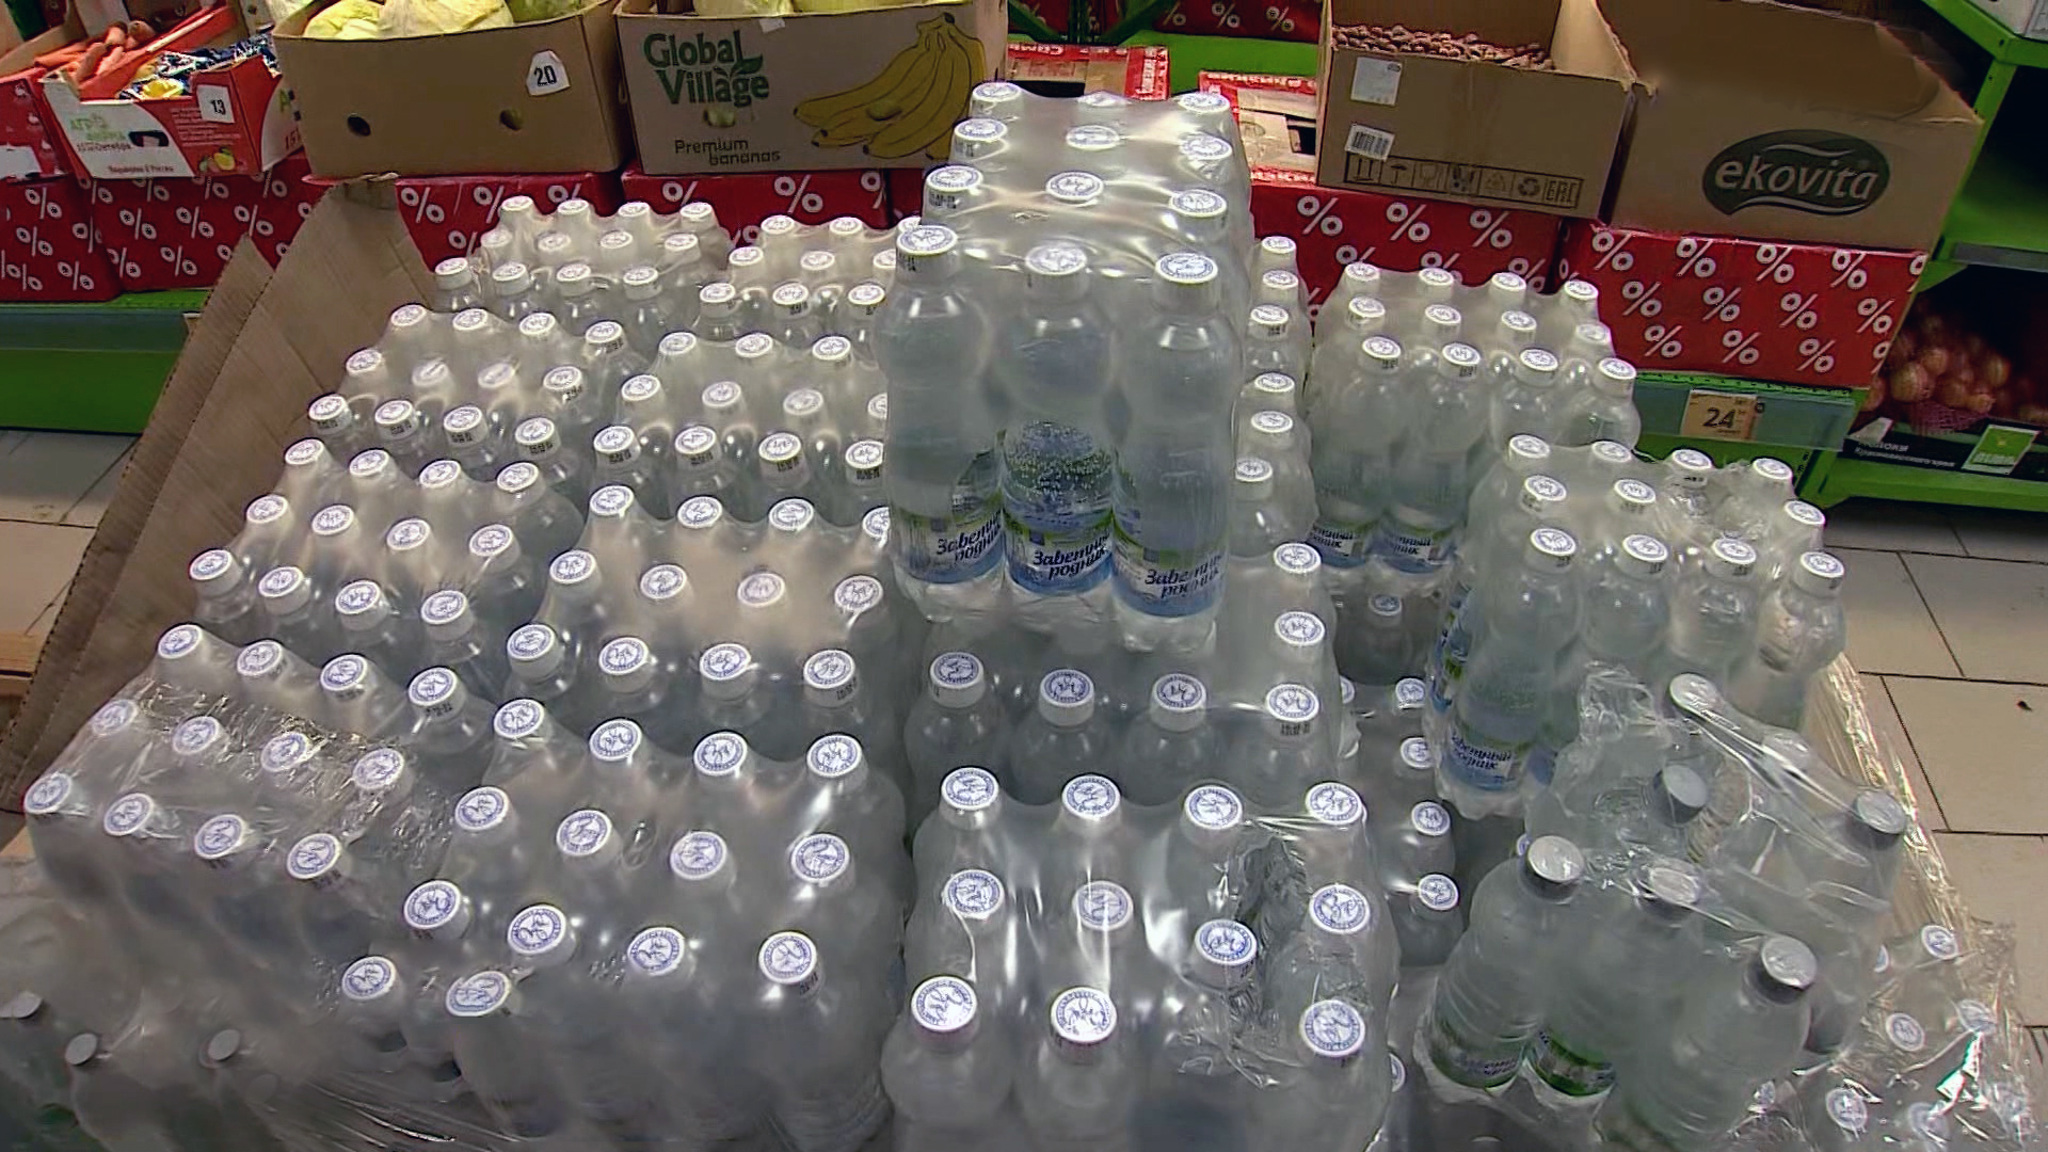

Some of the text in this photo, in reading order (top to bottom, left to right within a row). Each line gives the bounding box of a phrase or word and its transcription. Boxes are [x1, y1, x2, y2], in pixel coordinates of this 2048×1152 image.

[643, 29, 748, 69] Global
[533, 64, 558, 87] 20
[655, 69, 770, 109] Village
[209, 98, 227, 116] 13
[674, 139, 749, 155] Premium
[708, 149, 782, 167] bananas
[1714, 153, 1879, 201] ekovita
[1702, 406, 1737, 429] 24
